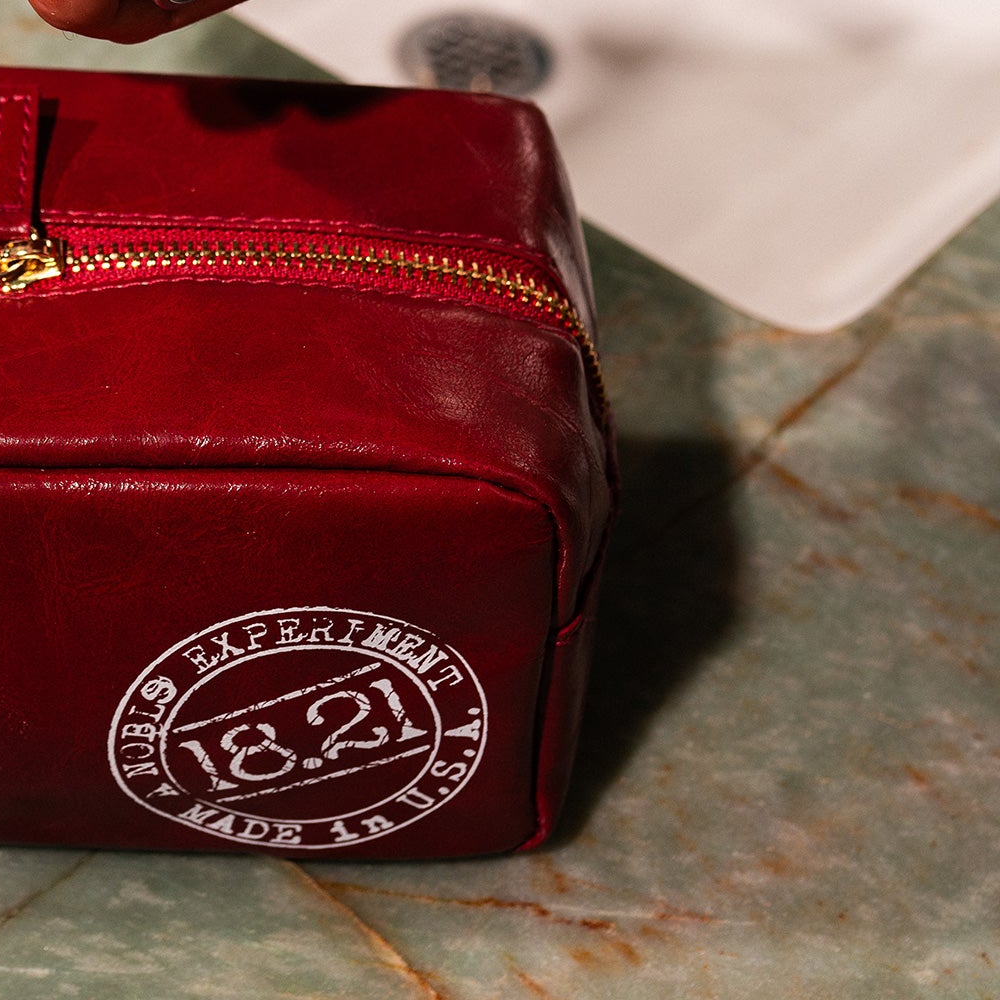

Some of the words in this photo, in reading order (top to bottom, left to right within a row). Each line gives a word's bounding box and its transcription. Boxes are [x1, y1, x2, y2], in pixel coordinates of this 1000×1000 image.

[182, 617, 463, 692] EXPERIMENT
[178, 678, 428, 792] 18.21
[178, 804, 302, 845] MADE
[330, 814, 395, 842] in
[396, 707, 482, 809] U.S.A.
